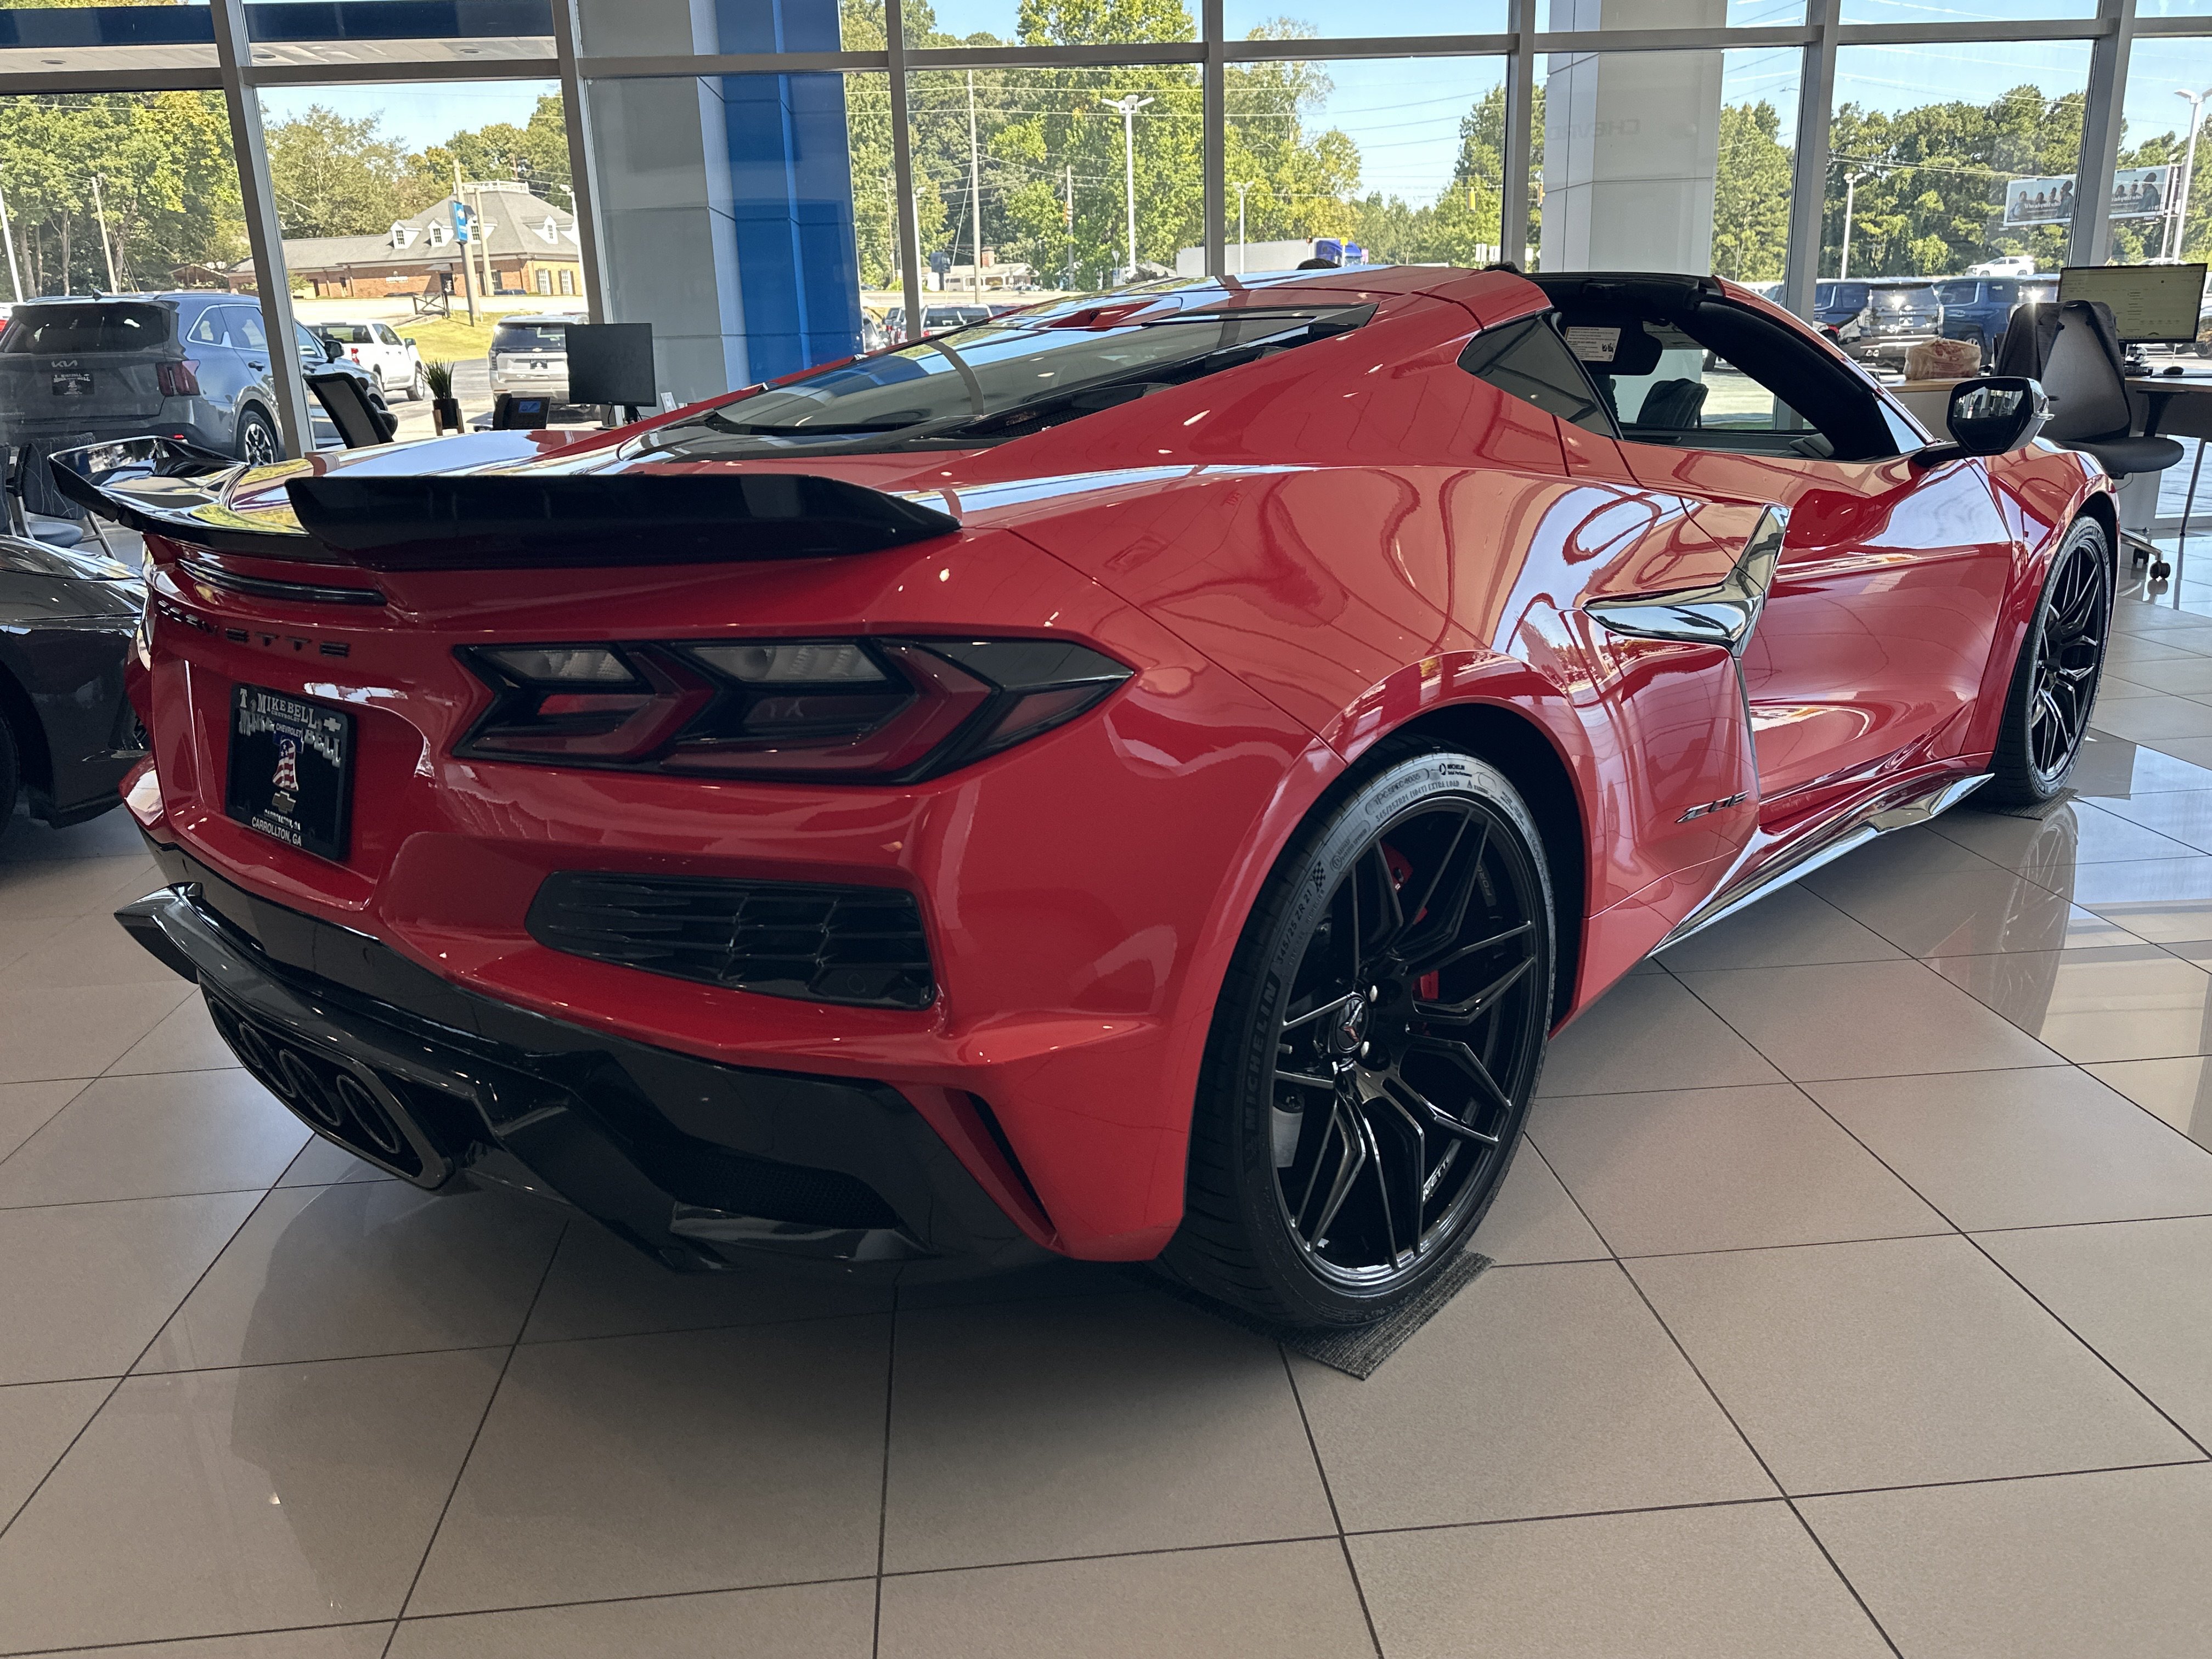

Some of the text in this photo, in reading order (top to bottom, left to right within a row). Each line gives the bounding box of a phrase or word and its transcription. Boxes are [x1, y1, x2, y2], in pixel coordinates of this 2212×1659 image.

[257, 693, 286, 714] MIKE
[287, 701, 317, 730] BELL
[270, 710, 301, 723] CHEVROLET
[275, 723, 302, 738] CHEVROLET
[252, 816, 292, 844] CARROLLTON,
[292, 833, 302, 847] GA
[1277, 921, 1297, 965] 345/25
[1294, 904, 1306, 921] ZR
[1304, 888, 1313, 905] 21
[1245, 981, 1277, 1130] MICHELIN
